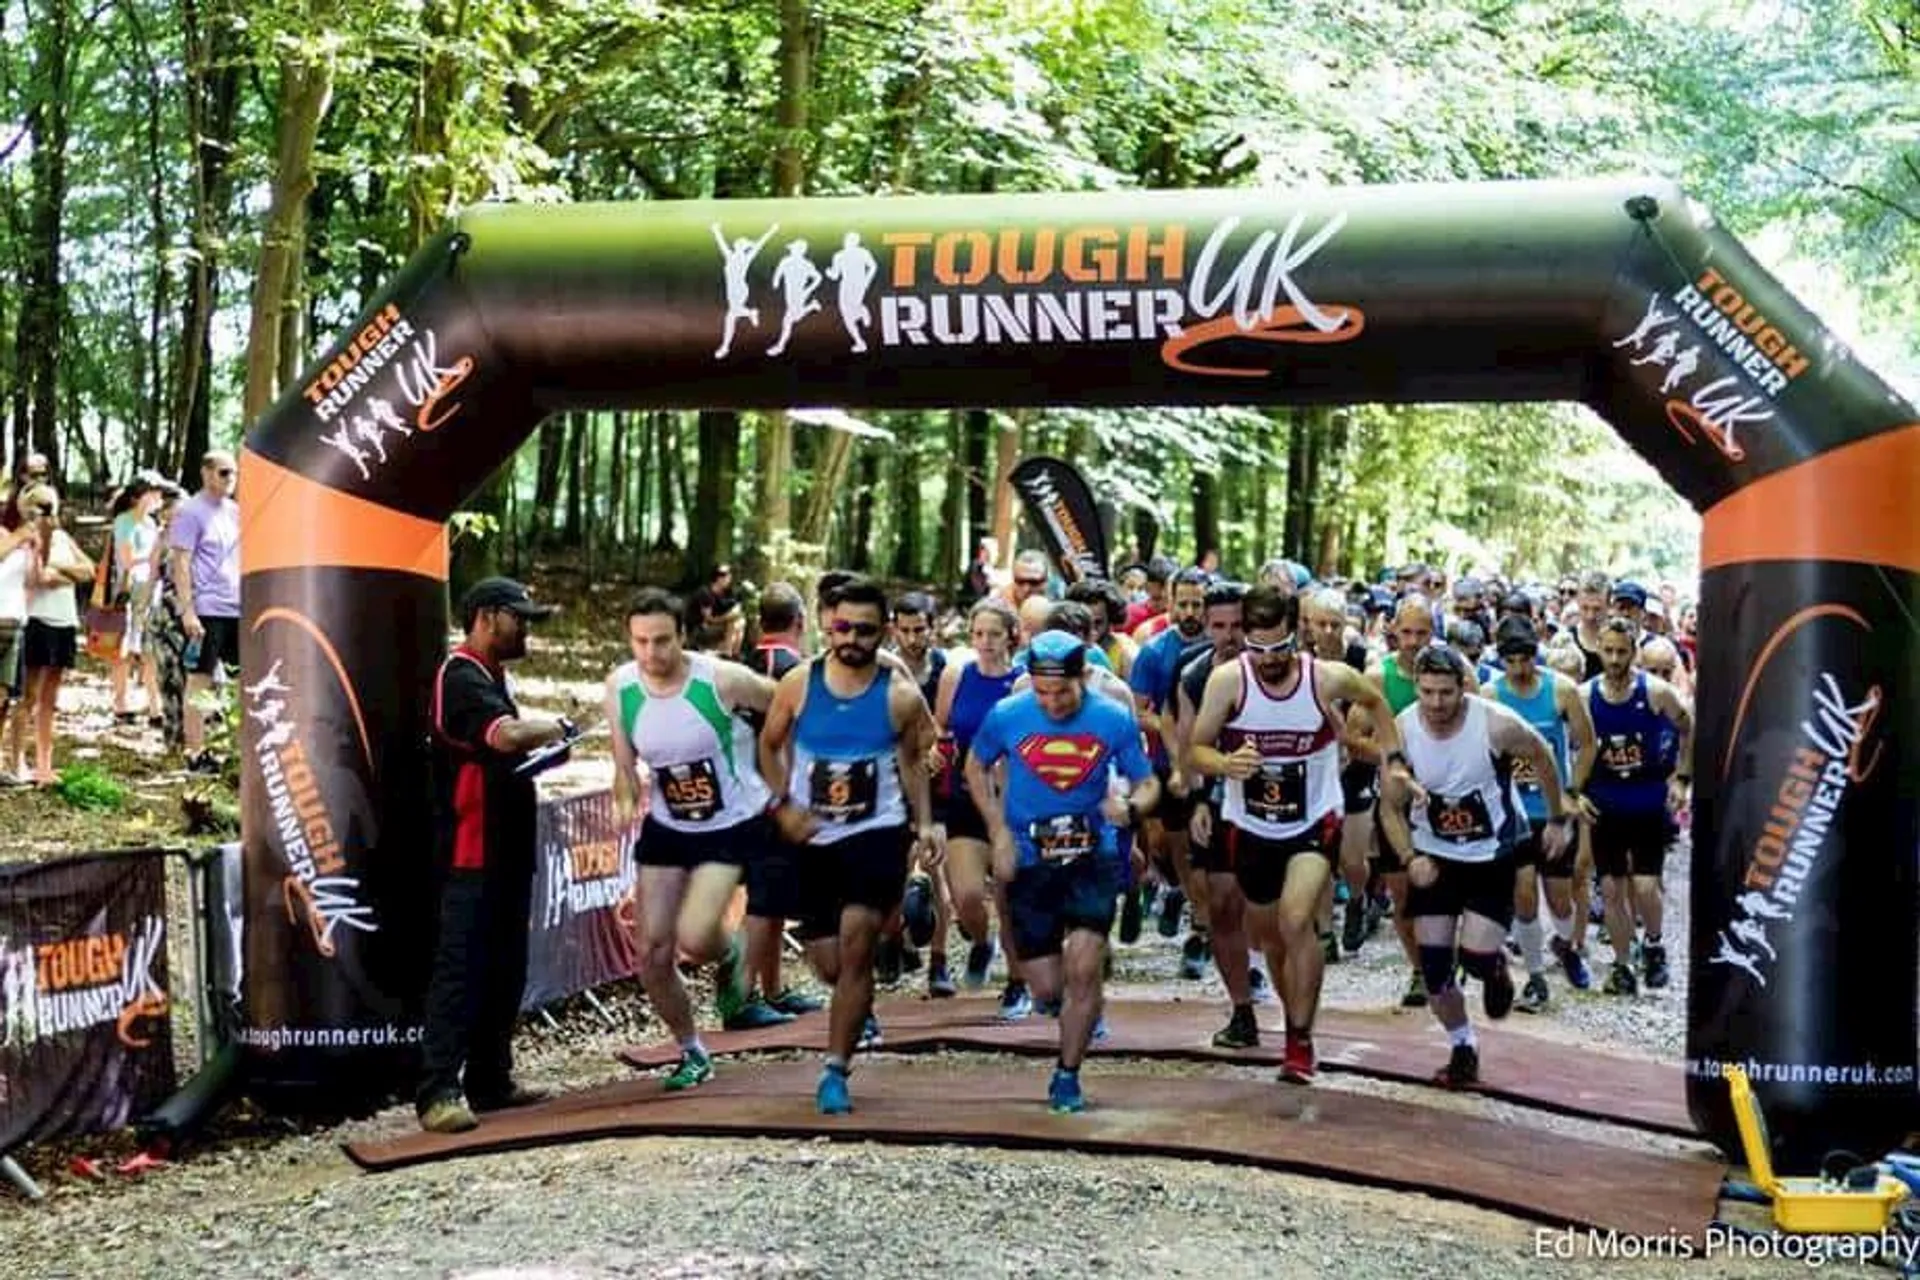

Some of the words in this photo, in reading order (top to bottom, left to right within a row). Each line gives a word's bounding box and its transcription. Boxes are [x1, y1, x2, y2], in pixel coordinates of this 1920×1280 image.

[883, 225, 1190, 287] TOUGH
[1189, 212, 1348, 333] UK
[302, 302, 400, 403] TOUGH
[881, 288, 1184, 346] RUNNER
[1674, 283, 1788, 397] RUNNER
[1697, 267, 1810, 379] TOUGH
[314, 319, 415, 423] RUNNER
[395, 329, 460, 405] UK
[1692, 376, 1776, 451] UK
[1801, 672, 1880, 758] UK
[260, 748, 317, 882] RUNNER
[280, 739, 347, 874] TOUGH
[666, 777, 713, 801] 455
[829, 780, 850, 805] 9
[1263, 781, 1282, 803] 3
[1439, 810, 1473, 831] 20
[1744, 748, 1828, 889] TOUGH
[1773, 759, 1851, 904] RUNNER
[310, 877, 378, 943] UK
[38, 933, 125, 990] TOUGH
